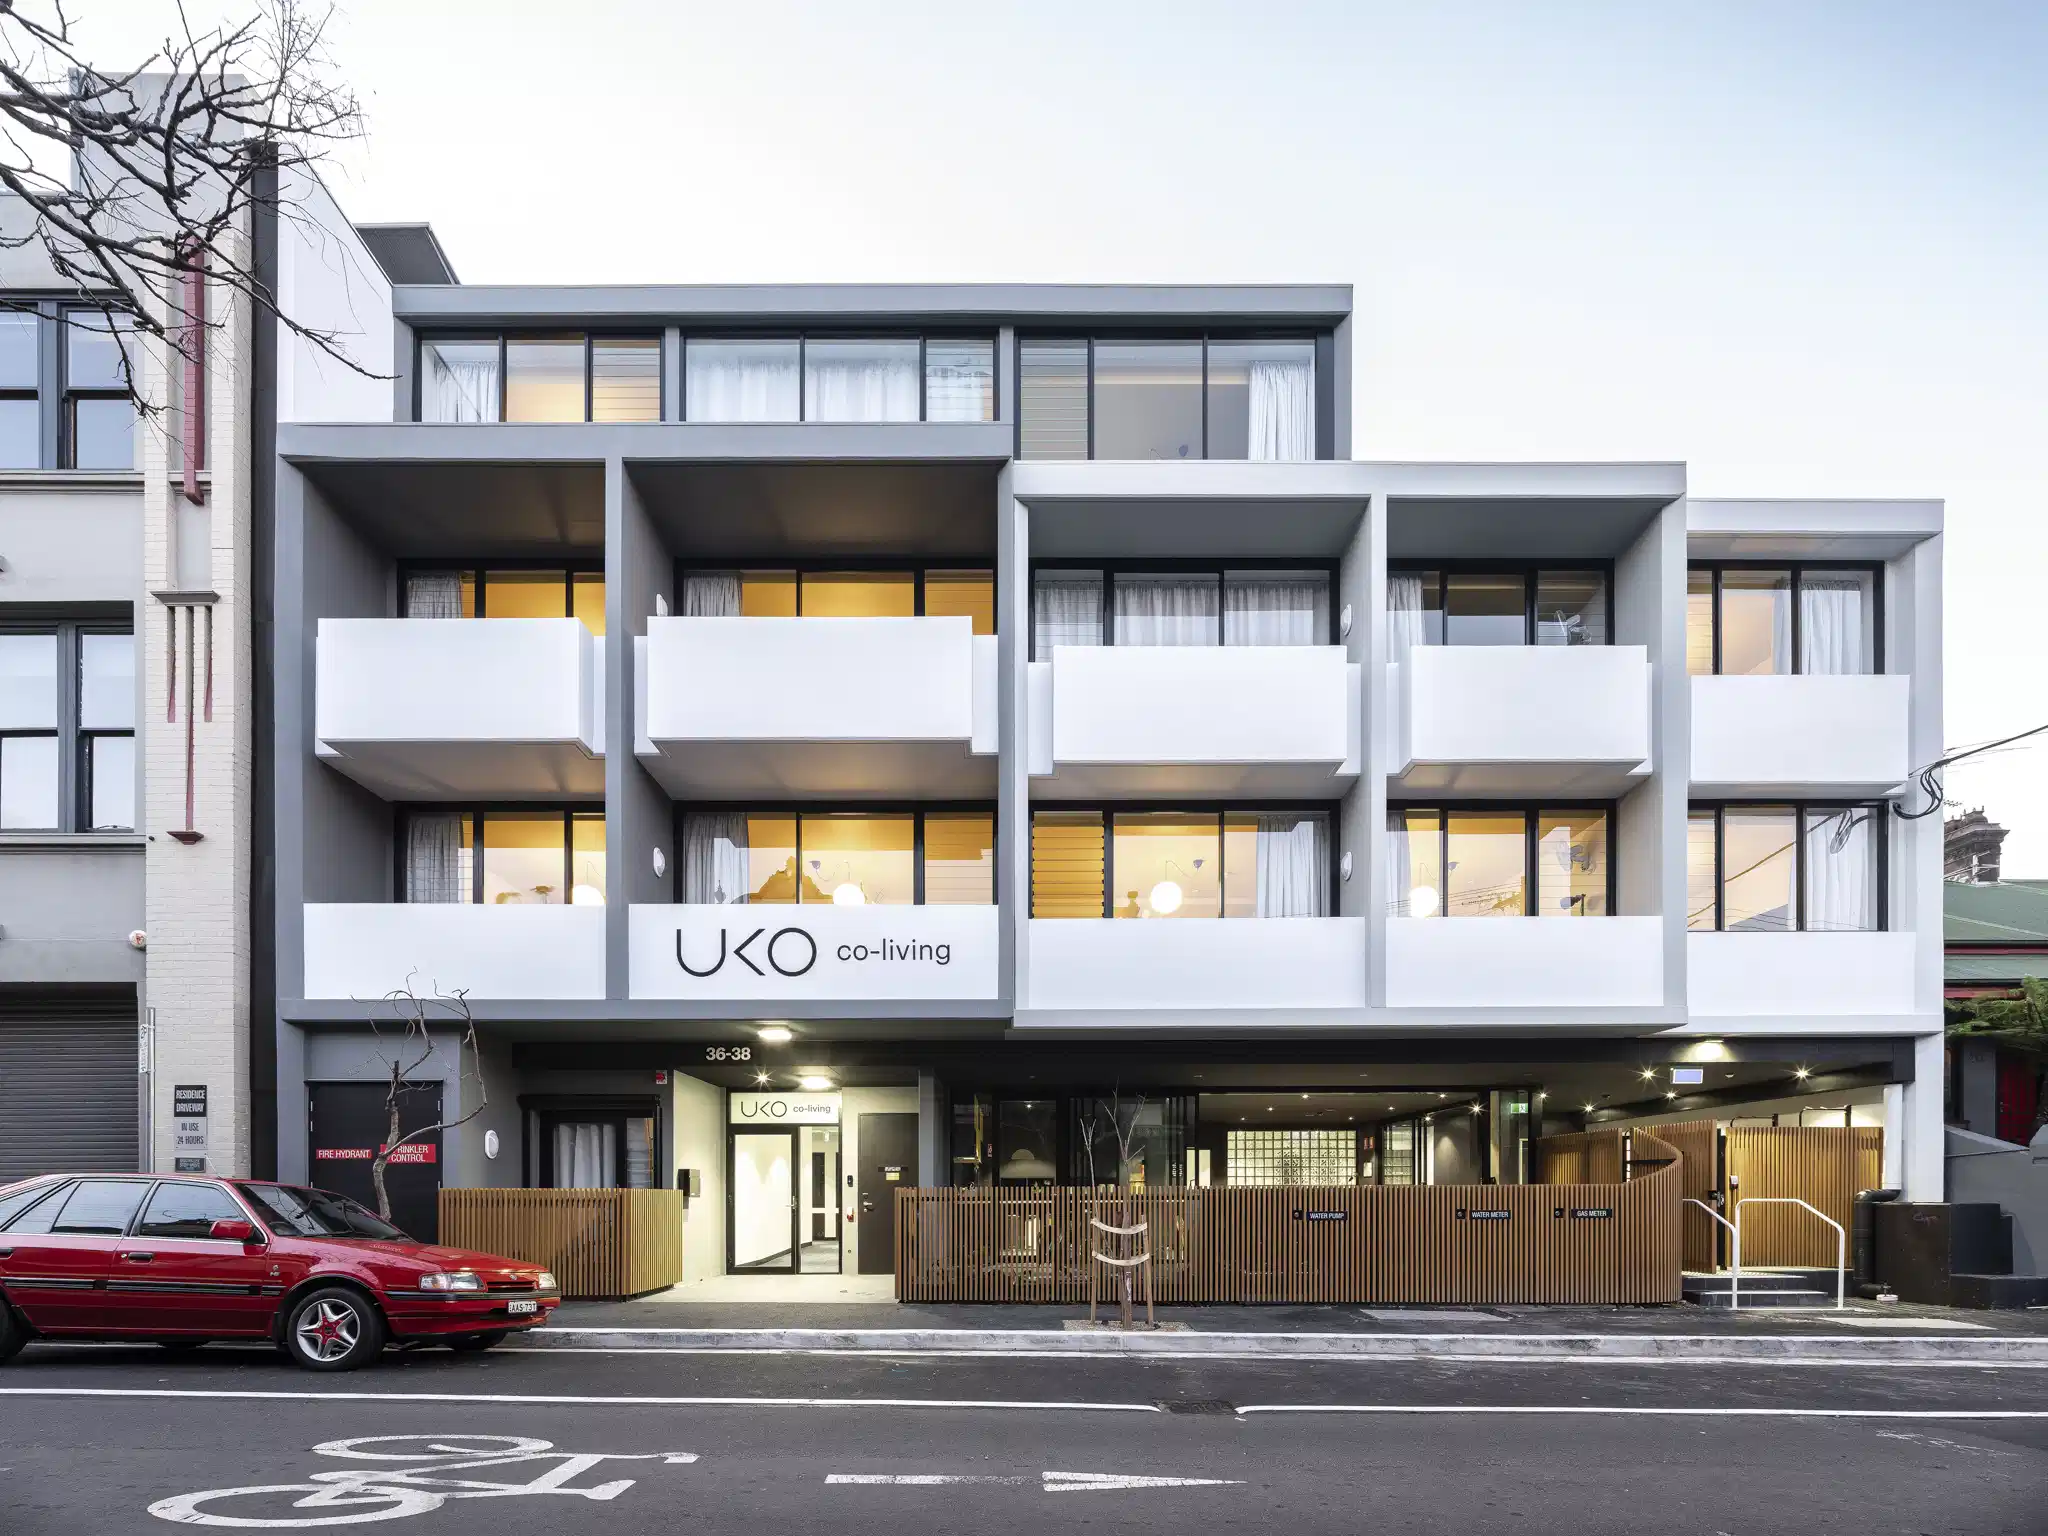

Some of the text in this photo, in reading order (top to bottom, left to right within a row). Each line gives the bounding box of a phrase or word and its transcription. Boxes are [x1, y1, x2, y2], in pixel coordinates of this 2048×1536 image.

[676, 927, 951, 977] UKO co-living
[706, 1047, 751, 1061] 36-38
[175, 1089, 206, 1100] RESIDENCE
[176, 1102, 205, 1112] DRIVEWAY
[740, 1101, 832, 1118] UKO co-living
[181, 1122, 200, 1131] IN USE
[177, 1135, 204, 1145] 24 HOURS
[318, 1149, 370, 1159] FIRE HYDRANT
[393, 1145, 429, 1154] RINKLER
[391, 1153, 426, 1162] CONTROL
